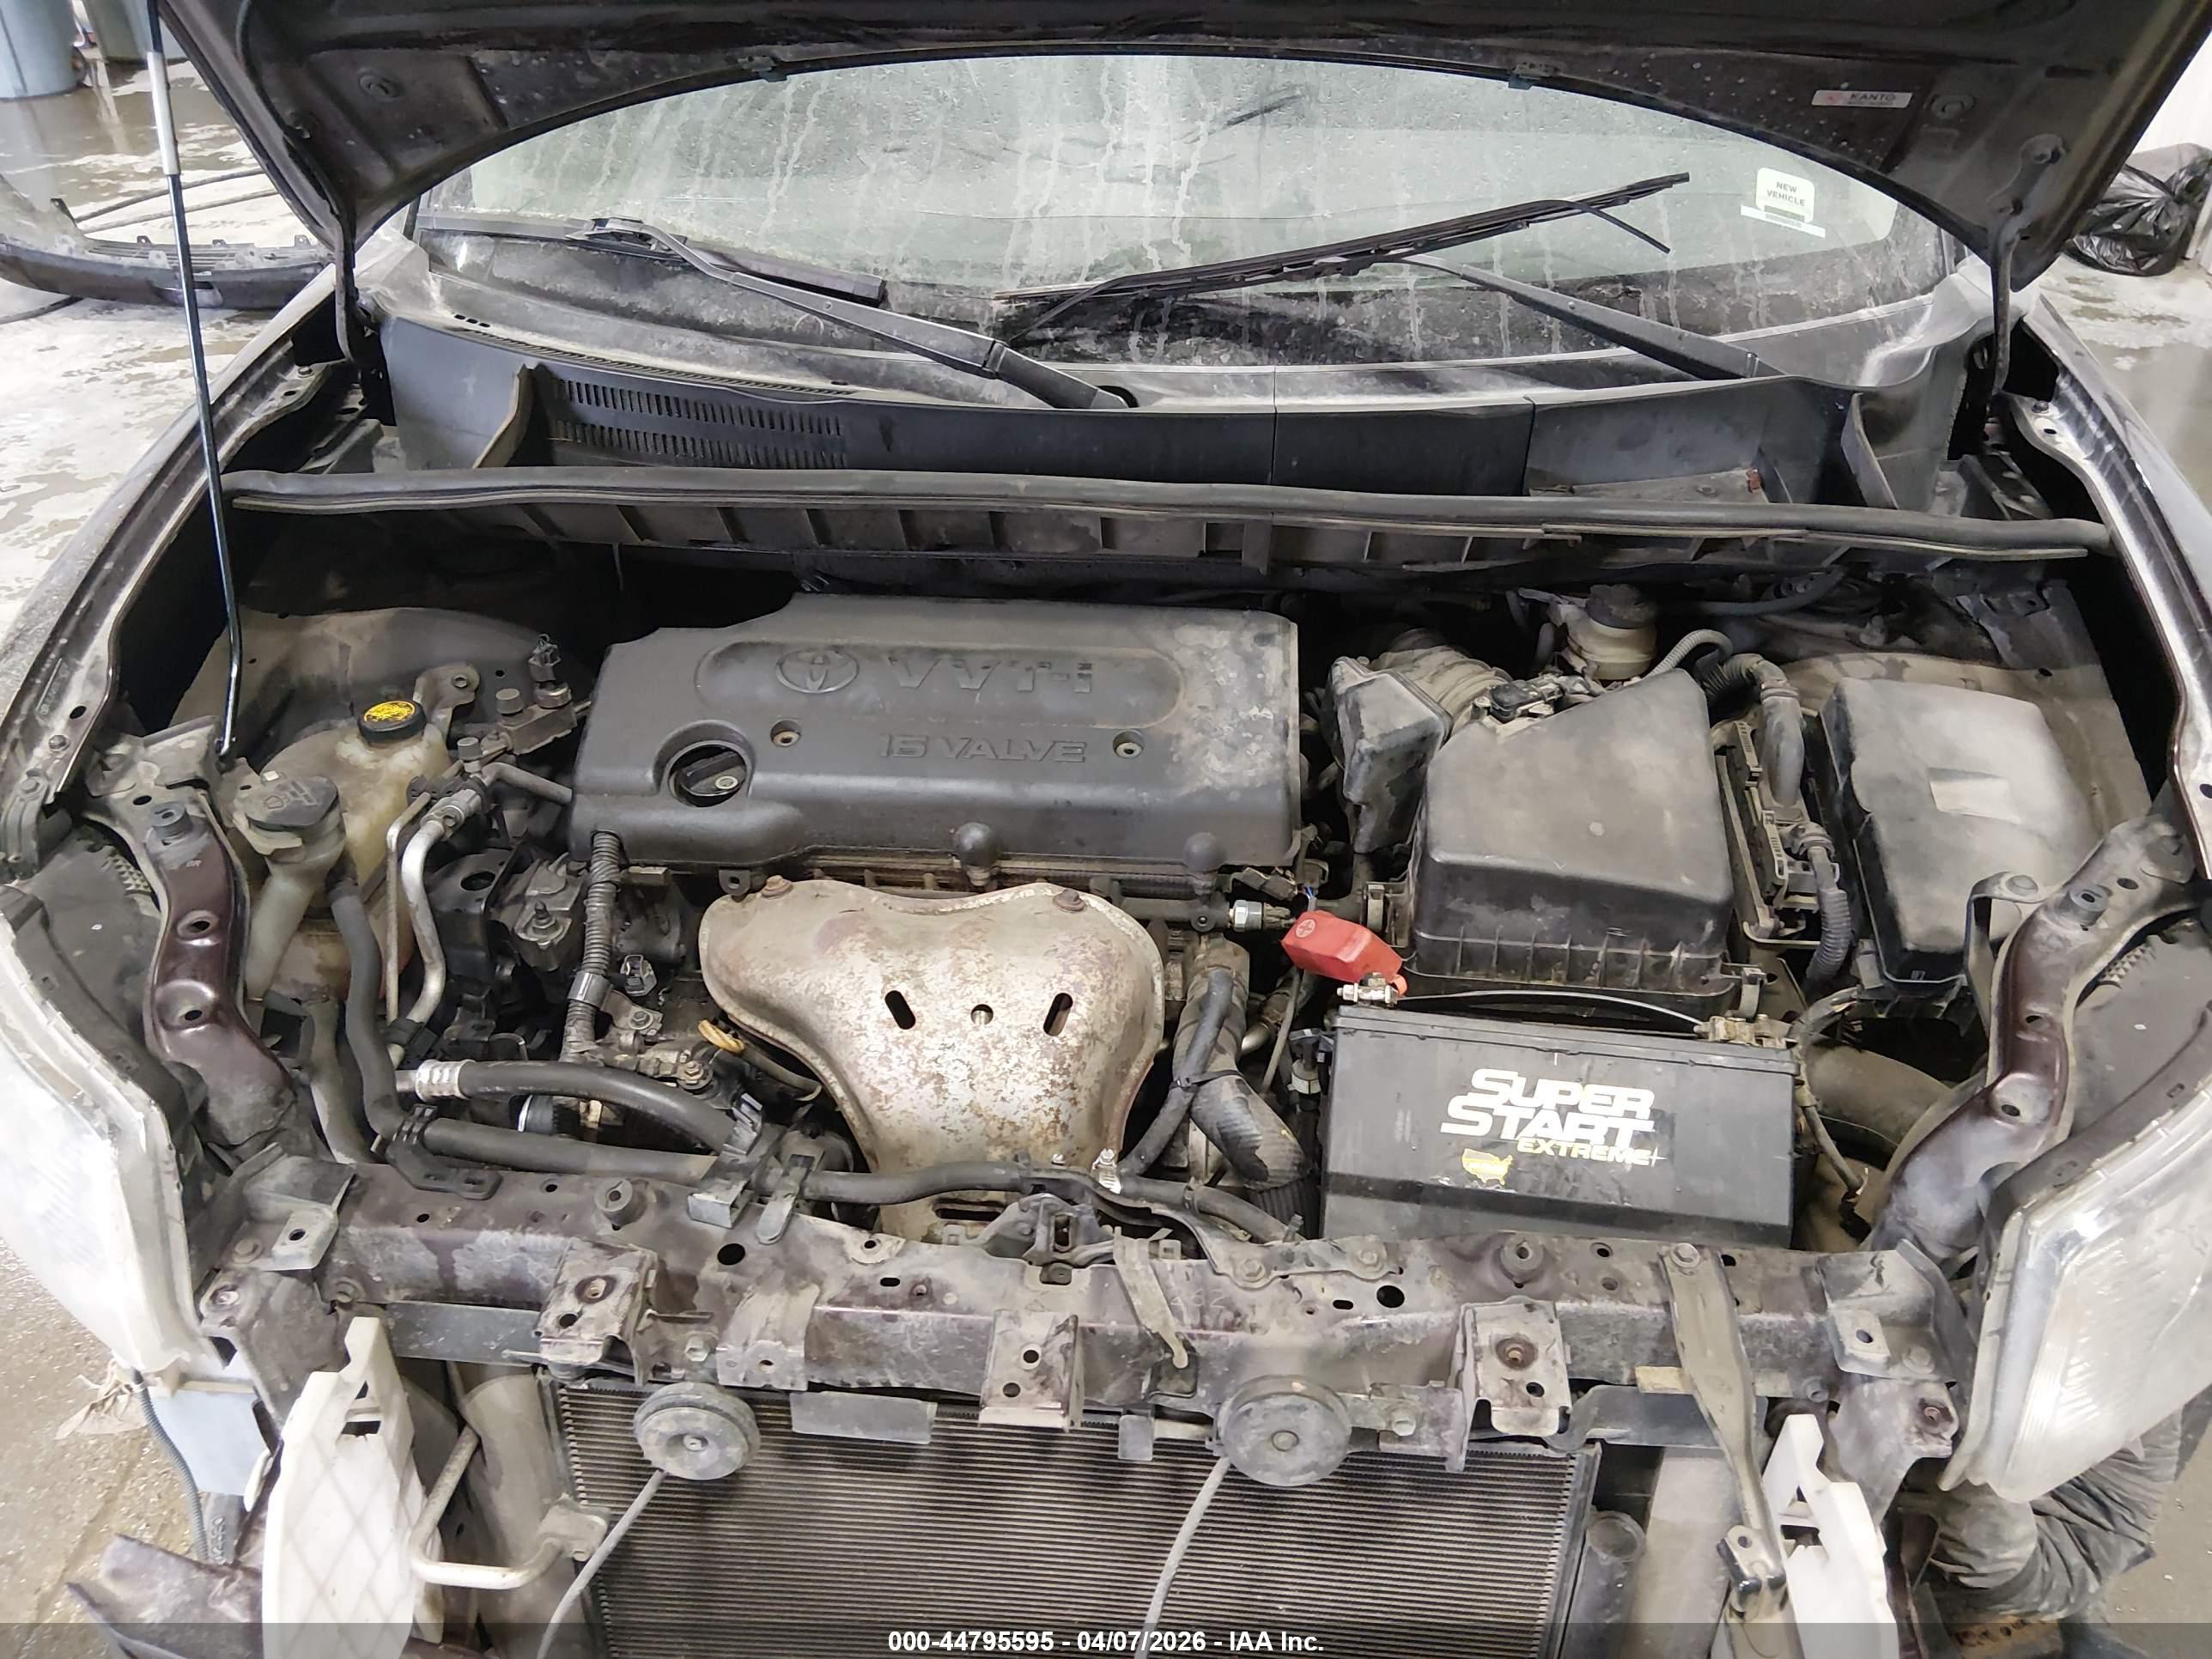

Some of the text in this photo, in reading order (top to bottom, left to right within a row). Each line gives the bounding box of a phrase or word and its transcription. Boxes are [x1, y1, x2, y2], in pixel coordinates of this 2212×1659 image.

[1766, 190, 1806, 207] VEHICLE
[1776, 181, 1797, 193] NEW
[886, 654, 1093, 694] VVT-i
[941, 736, 1088, 763] VALVE
[1471, 1068, 1656, 1121] SUPER
[1439, 1091, 1656, 1149] START
